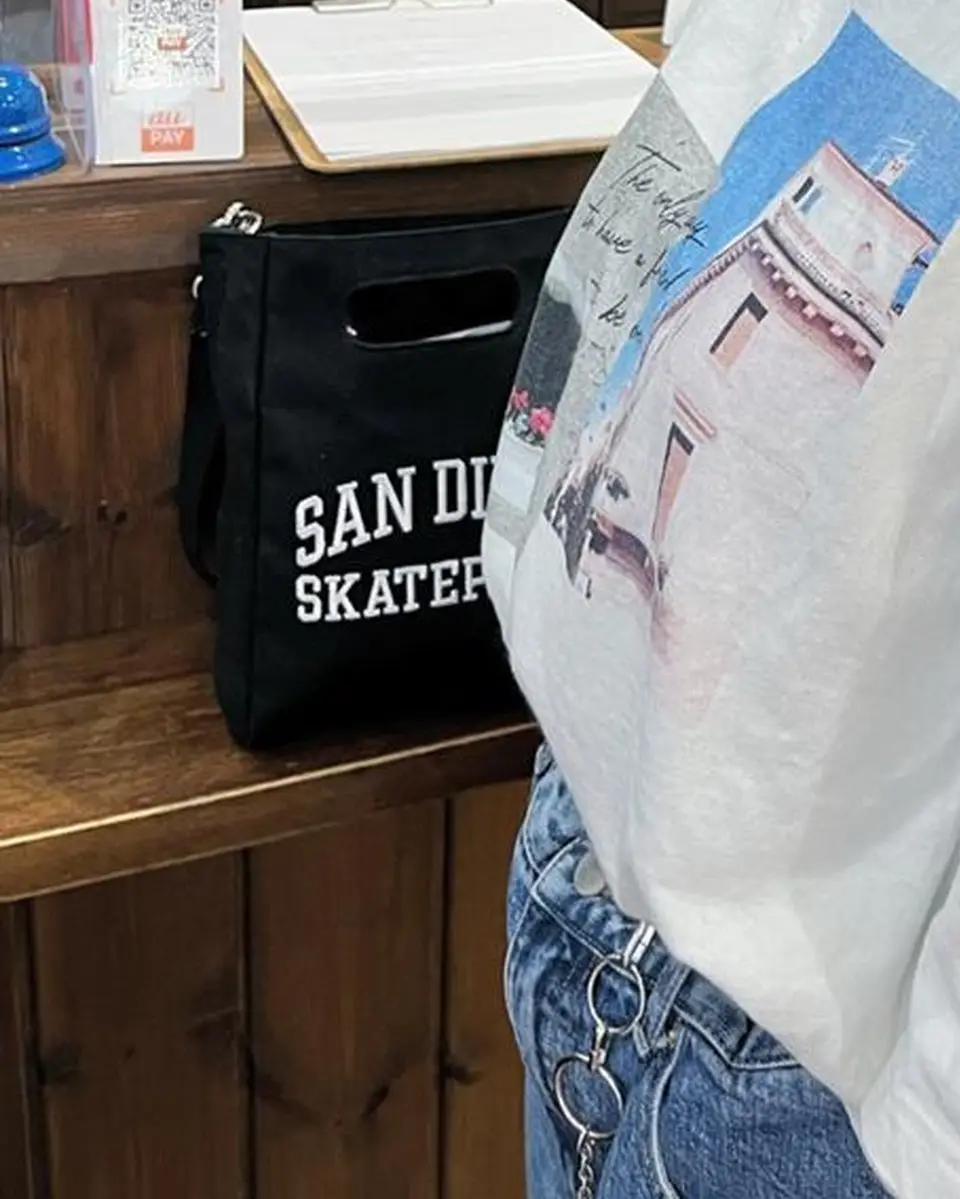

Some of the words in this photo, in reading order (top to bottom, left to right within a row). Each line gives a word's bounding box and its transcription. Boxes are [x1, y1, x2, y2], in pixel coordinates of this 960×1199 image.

[152, 130, 186, 146] PAY
[295, 466, 417, 568] SAN
[432, 454, 497, 524] DI
